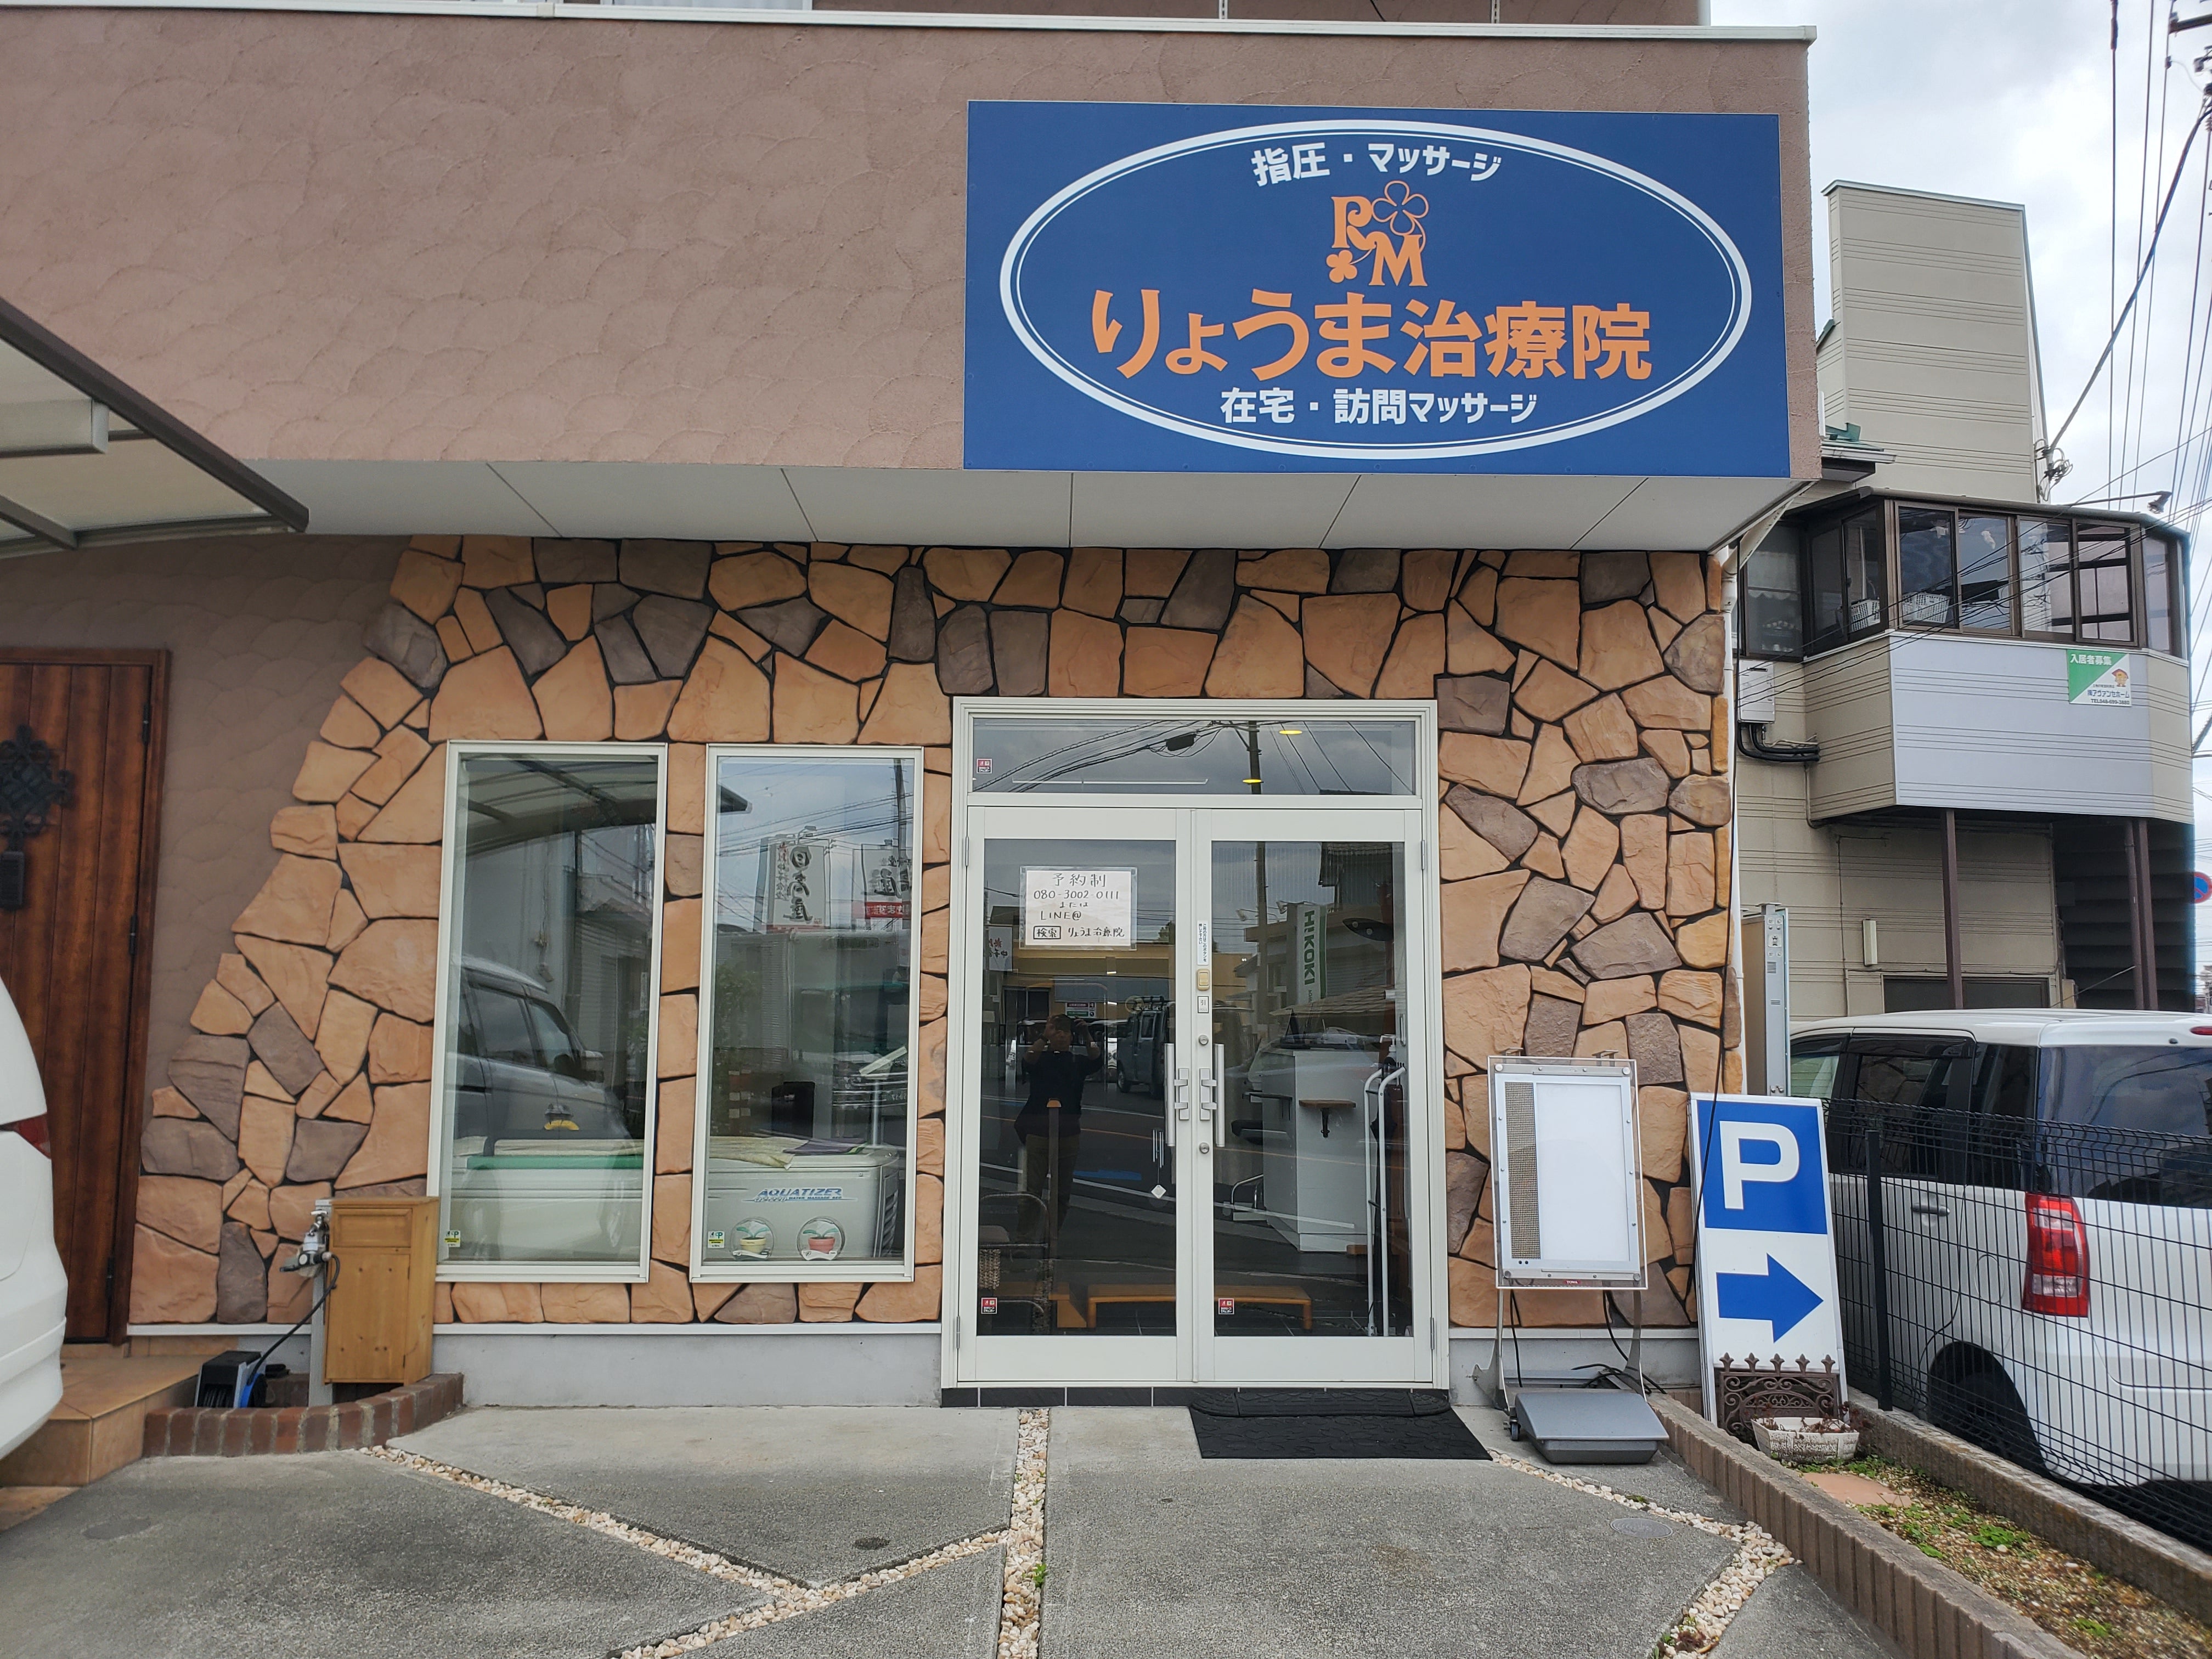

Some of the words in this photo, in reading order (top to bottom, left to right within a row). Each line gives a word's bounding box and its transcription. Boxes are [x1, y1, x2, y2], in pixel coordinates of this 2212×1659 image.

[1251, 142, 1502, 187] 指圧・マッサージ
[1092, 287, 1652, 381] りょうま治療院
[1220, 387, 1538, 425] 在宅・訪問マッサージ
[2070, 653, 2112, 665] 入居者募集
[1053, 873, 1105, 887] 予約制
[1034, 889, 1119, 899] 080-3002-0111
[1041, 911, 1082, 921] LINE@
[1036, 928, 1057, 938] 検索
[1719, 1120, 1799, 1210] P
